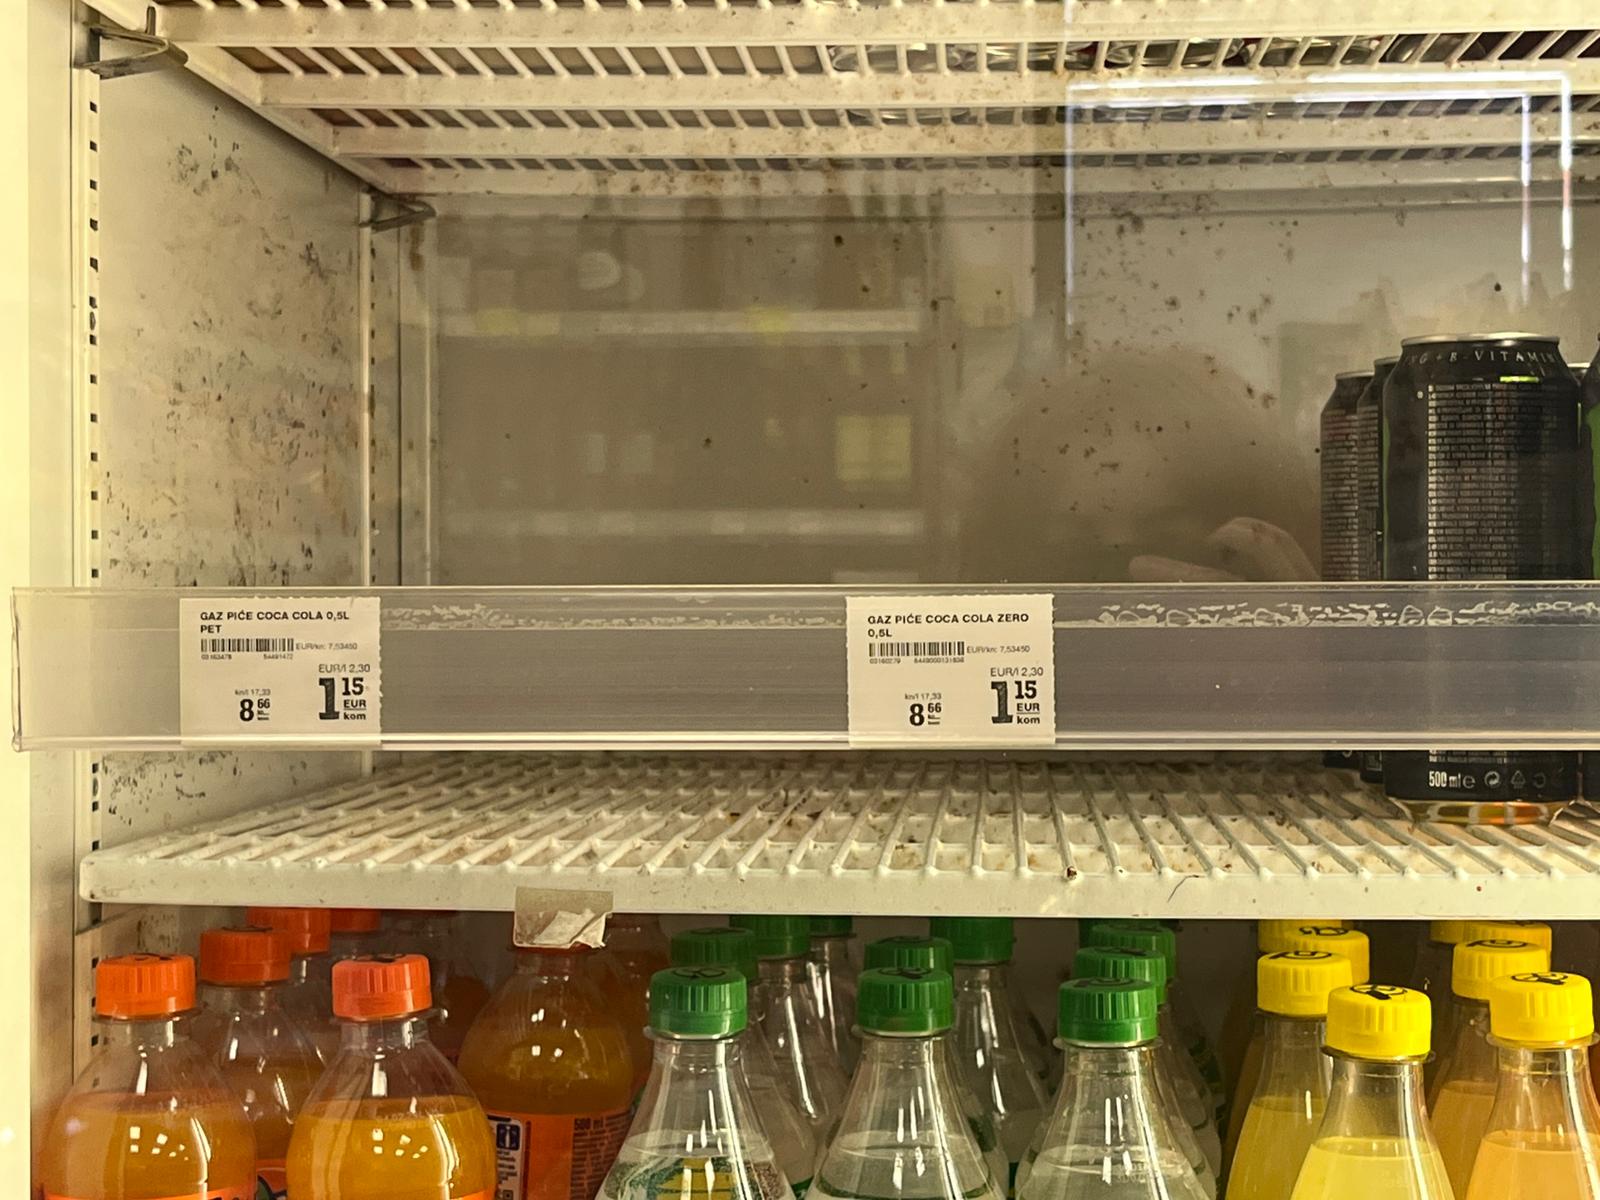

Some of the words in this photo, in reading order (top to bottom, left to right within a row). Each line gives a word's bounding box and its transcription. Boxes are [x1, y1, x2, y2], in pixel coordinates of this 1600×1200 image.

[200, 611, 223, 620] GAZ
[227, 609, 253, 620] PIĆE
[257, 611, 289, 620] COCA
[292, 611, 323, 620] COLA
[326, 611, 350, 621] 0,5L
[868, 615, 892, 624] GAZ
[895, 613, 922, 624] PIĆE
[925, 615, 959, 624] COCA
[962, 614, 994, 623] COLA
[997, 613, 1029, 623] ZERO
[200, 625, 222, 634] PET
[867, 629, 892, 639] 0,5L
[1000, 645, 1031, 654] 7,53450
[349, 663, 371, 674] 2,30
[1021, 667, 1044, 677] 2,30
[318, 677, 340, 720] 1
[342, 677, 364, 696] 15
[344, 699, 366, 708] EUR
[991, 681, 1013, 724] 1
[1015, 680, 1037, 699] 15
[239, 698, 254, 722] 8
[257, 698, 271, 709] 66
[1017, 702, 1040, 712] EUR
[343, 712, 366, 721] kom
[909, 703, 925, 726] 8
[927, 702, 942, 713] 66
[1017, 716, 1040, 725] kom
[1429, 771, 1447, 788] 500
[1448, 773, 1461, 788] ml
